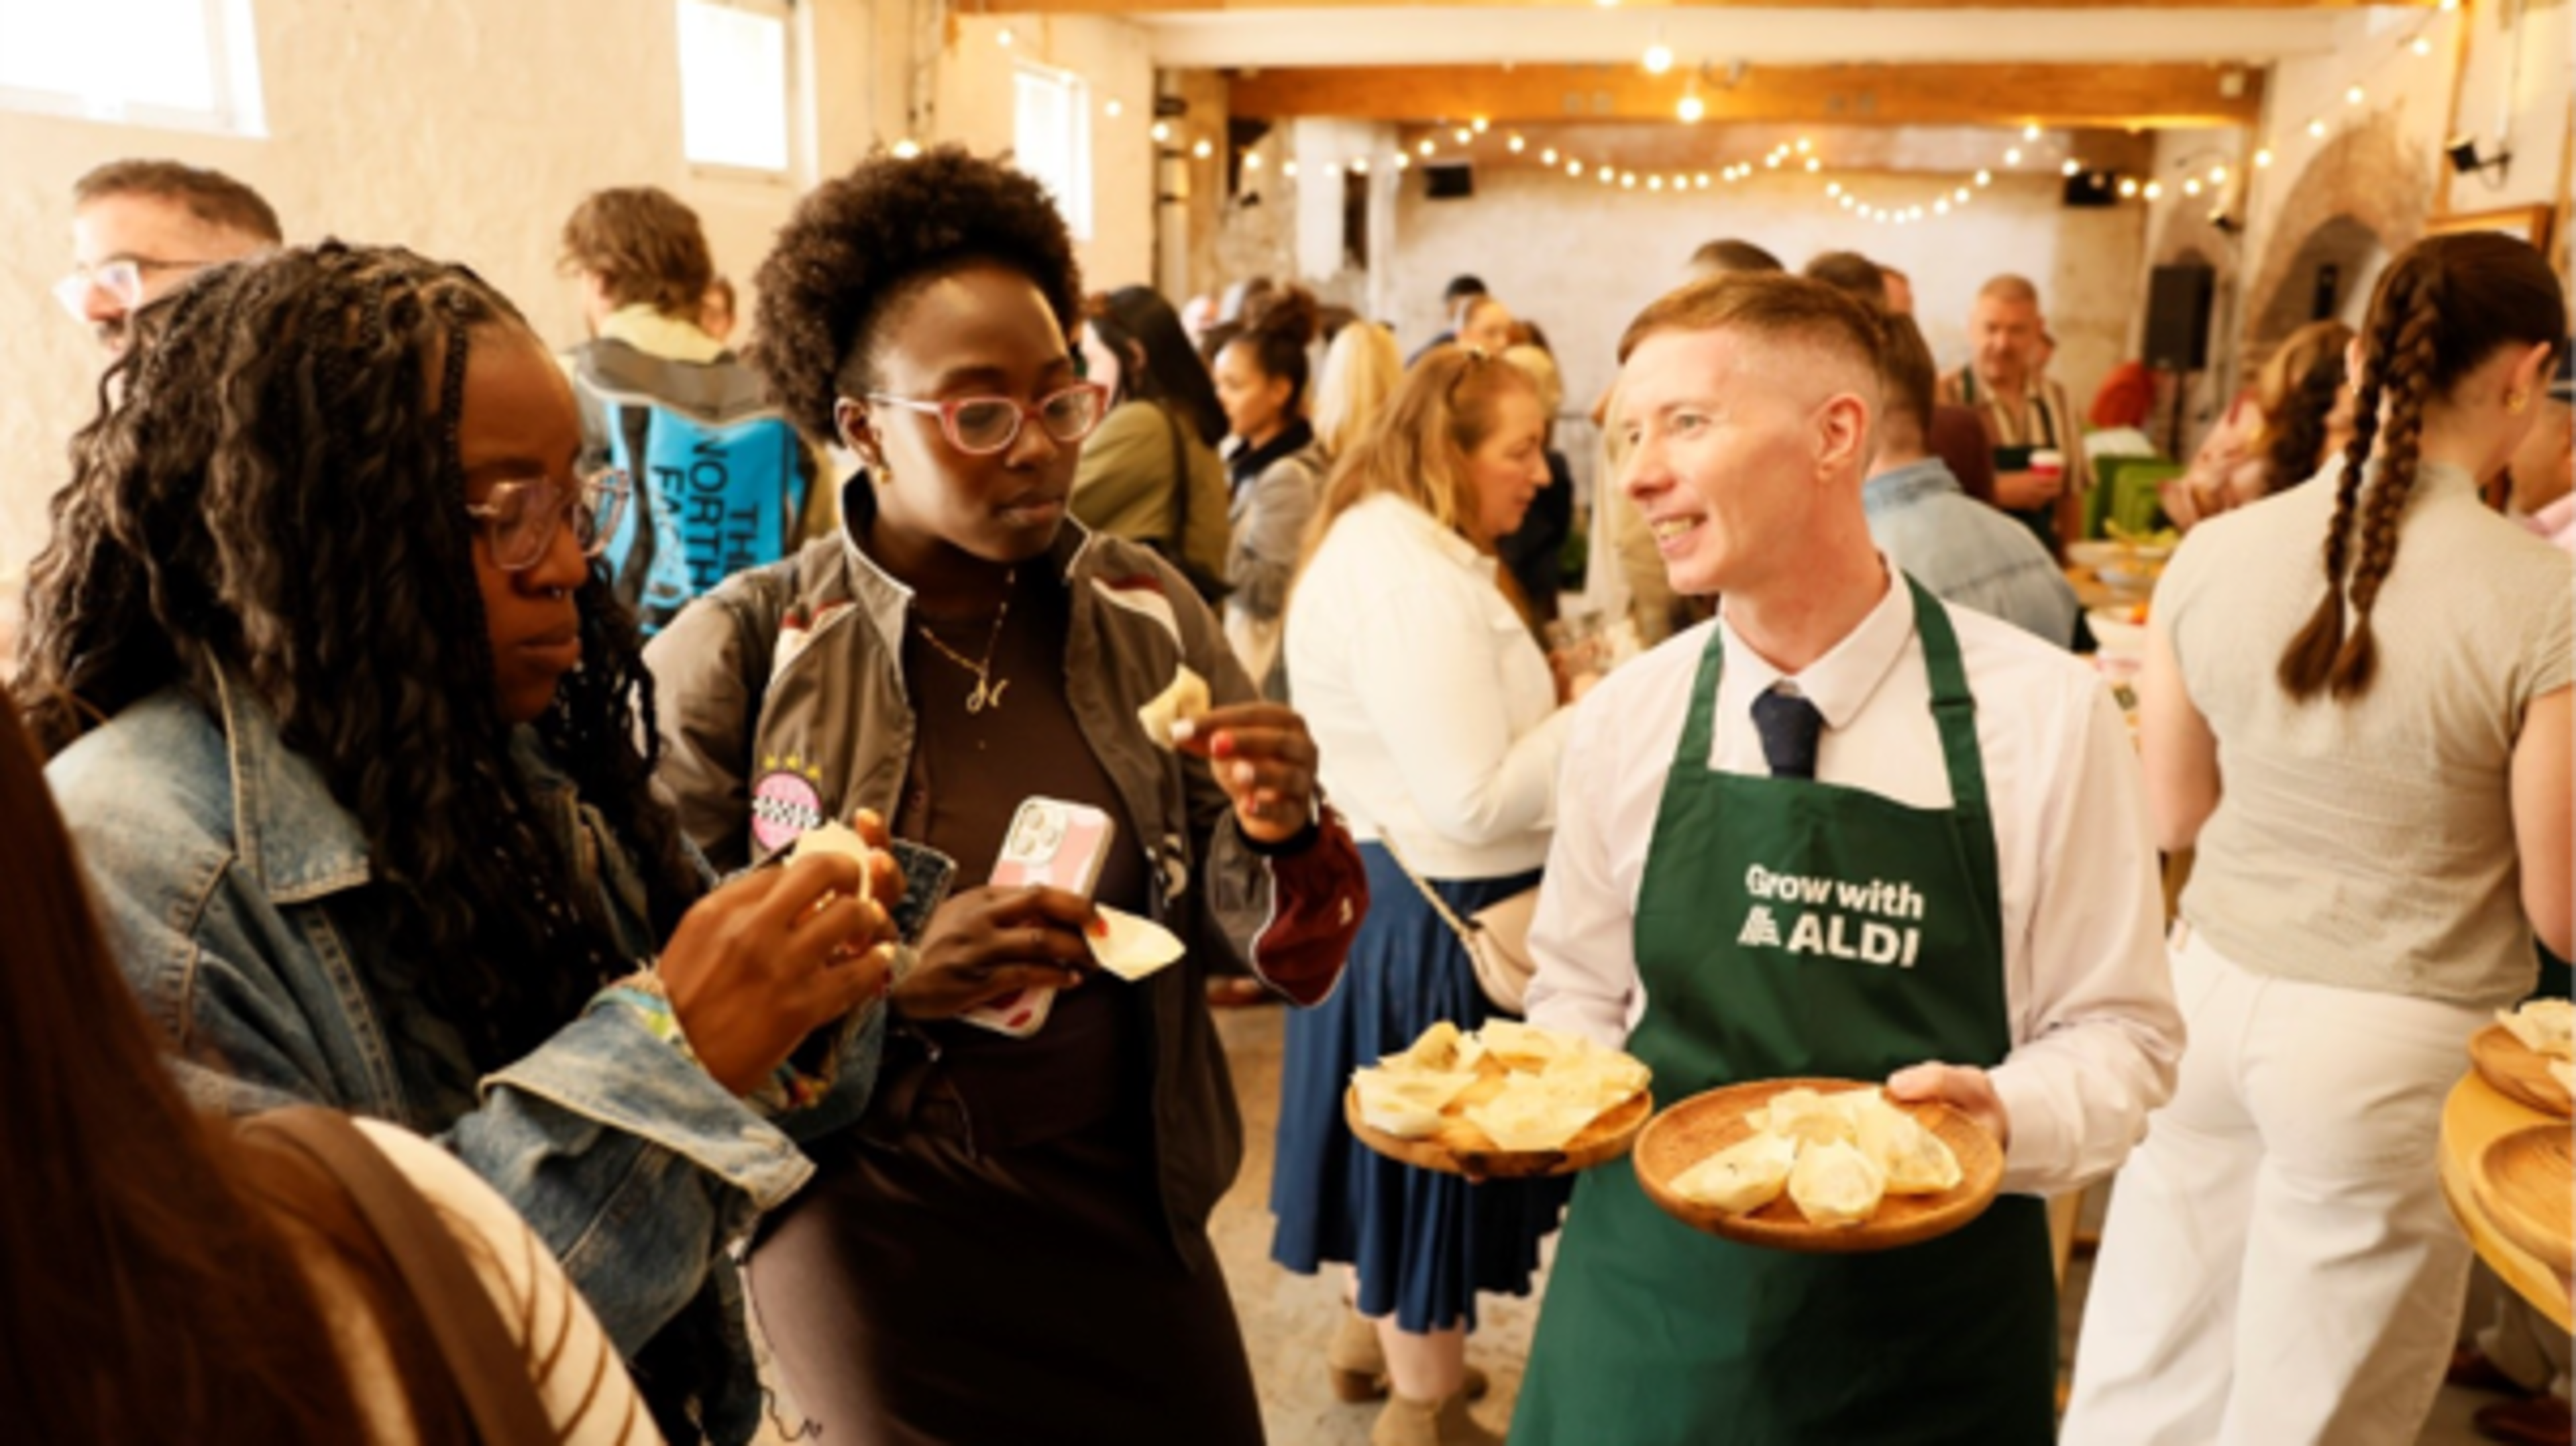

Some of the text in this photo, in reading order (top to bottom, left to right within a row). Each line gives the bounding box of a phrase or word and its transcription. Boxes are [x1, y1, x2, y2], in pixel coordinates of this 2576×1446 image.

[1746, 863, 1924, 920] Grow with
[1786, 912, 1919, 968] ALDI
